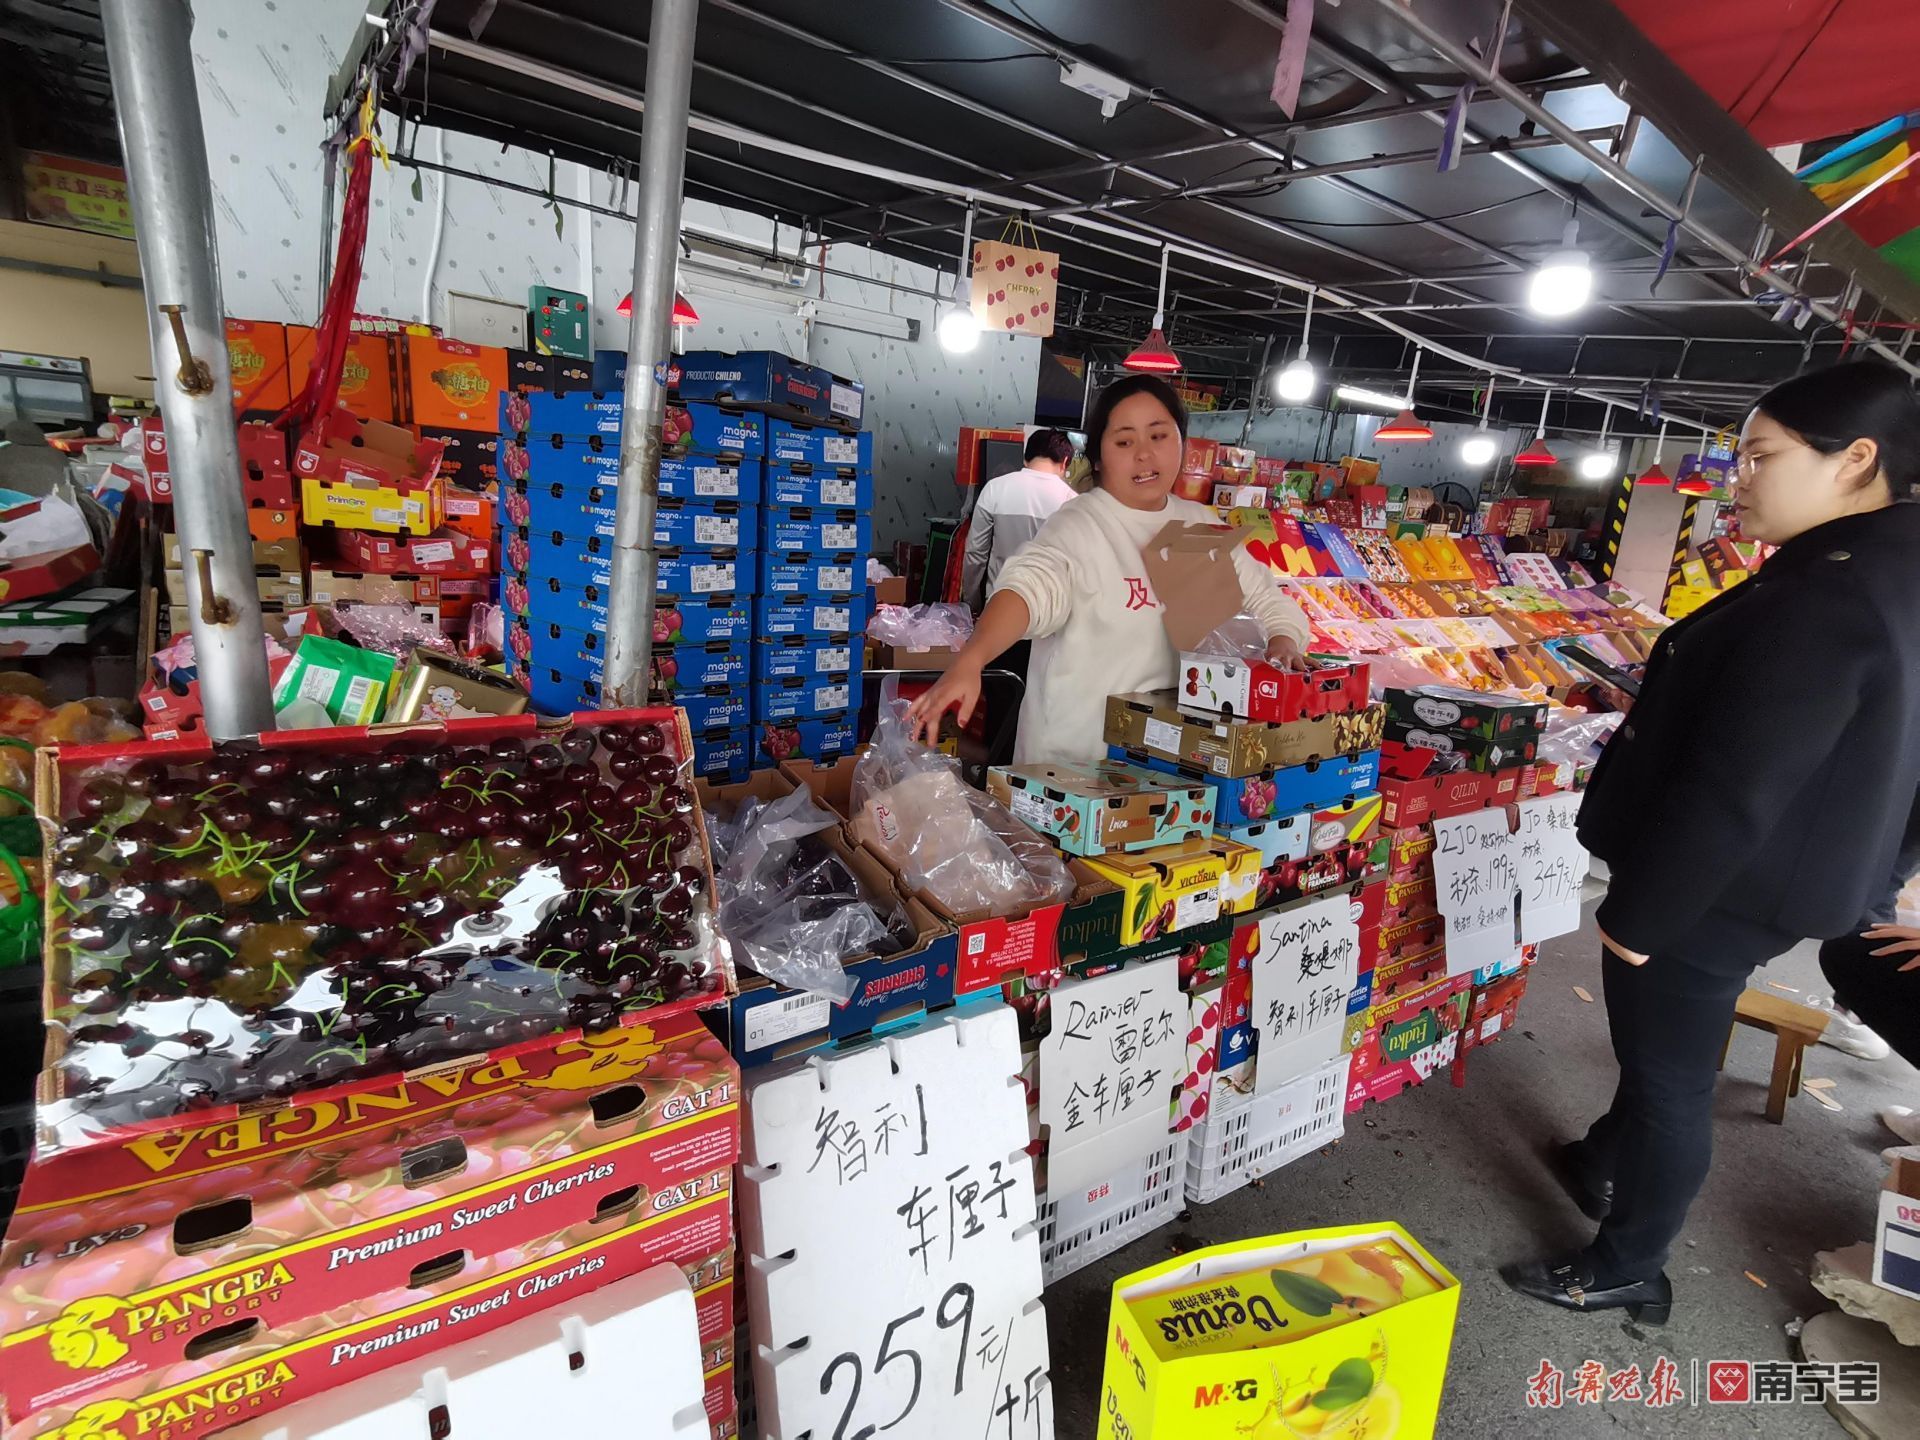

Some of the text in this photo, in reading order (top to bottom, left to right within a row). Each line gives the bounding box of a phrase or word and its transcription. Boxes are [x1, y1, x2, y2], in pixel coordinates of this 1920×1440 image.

[1007, 283, 1041, 296] CHERRY
[686, 370, 742, 381] PRODUCTO CHILENO
[1123, 577, 1156, 611] 及
[1450, 781, 1481, 801] QILIN
[1180, 870, 1217, 888] VICTORIA
[1308, 872, 1320, 880] SAN
[1308, 874, 1339, 888] FRANCISCO
[1266, 916, 1332, 964] Santina
[864, 964, 926, 997] CHERRIES
[1379, 965, 1404, 980] PANGEA
[1059, 988, 1154, 1050] Rainier
[1266, 984, 1347, 1040] 智利车厘子
[1374, 1001, 1400, 1019] PANGEA
[1109, 1008, 1175, 1064] 雷尼尔
[1388, 1022, 1427, 1052] Fudku
[122, 1056, 531, 1172] PANGEA
[662, 1083, 730, 1120] CAT 1
[1063, 1066, 1161, 1133] 金车厘子
[806, 1083, 929, 1185] 智利
[653, 1172, 721, 1211] CAT 1
[896, 1160, 1017, 1276] 车厘子
[20, 1223, 148, 1269] CAT 1
[125, 1160, 616, 1336] PANGEA Premium Sweet Cherries
[151, 1290, 282, 1343] EXPORT
[1157, 1295, 1289, 1342] Venus
[1168, 1285, 1241, 1313] 黄金维纳斯
[135, 1361, 297, 1435] PANGEA
[330, 1316, 441, 1366] Premium
[447, 1289, 512, 1326] Sweet
[517, 1254, 606, 1299] Cherries
[1115, 1323, 1147, 1392] M&G
[158, 1387, 284, 1440] EXPORT
[1193, 1378, 1258, 1409] M&G
